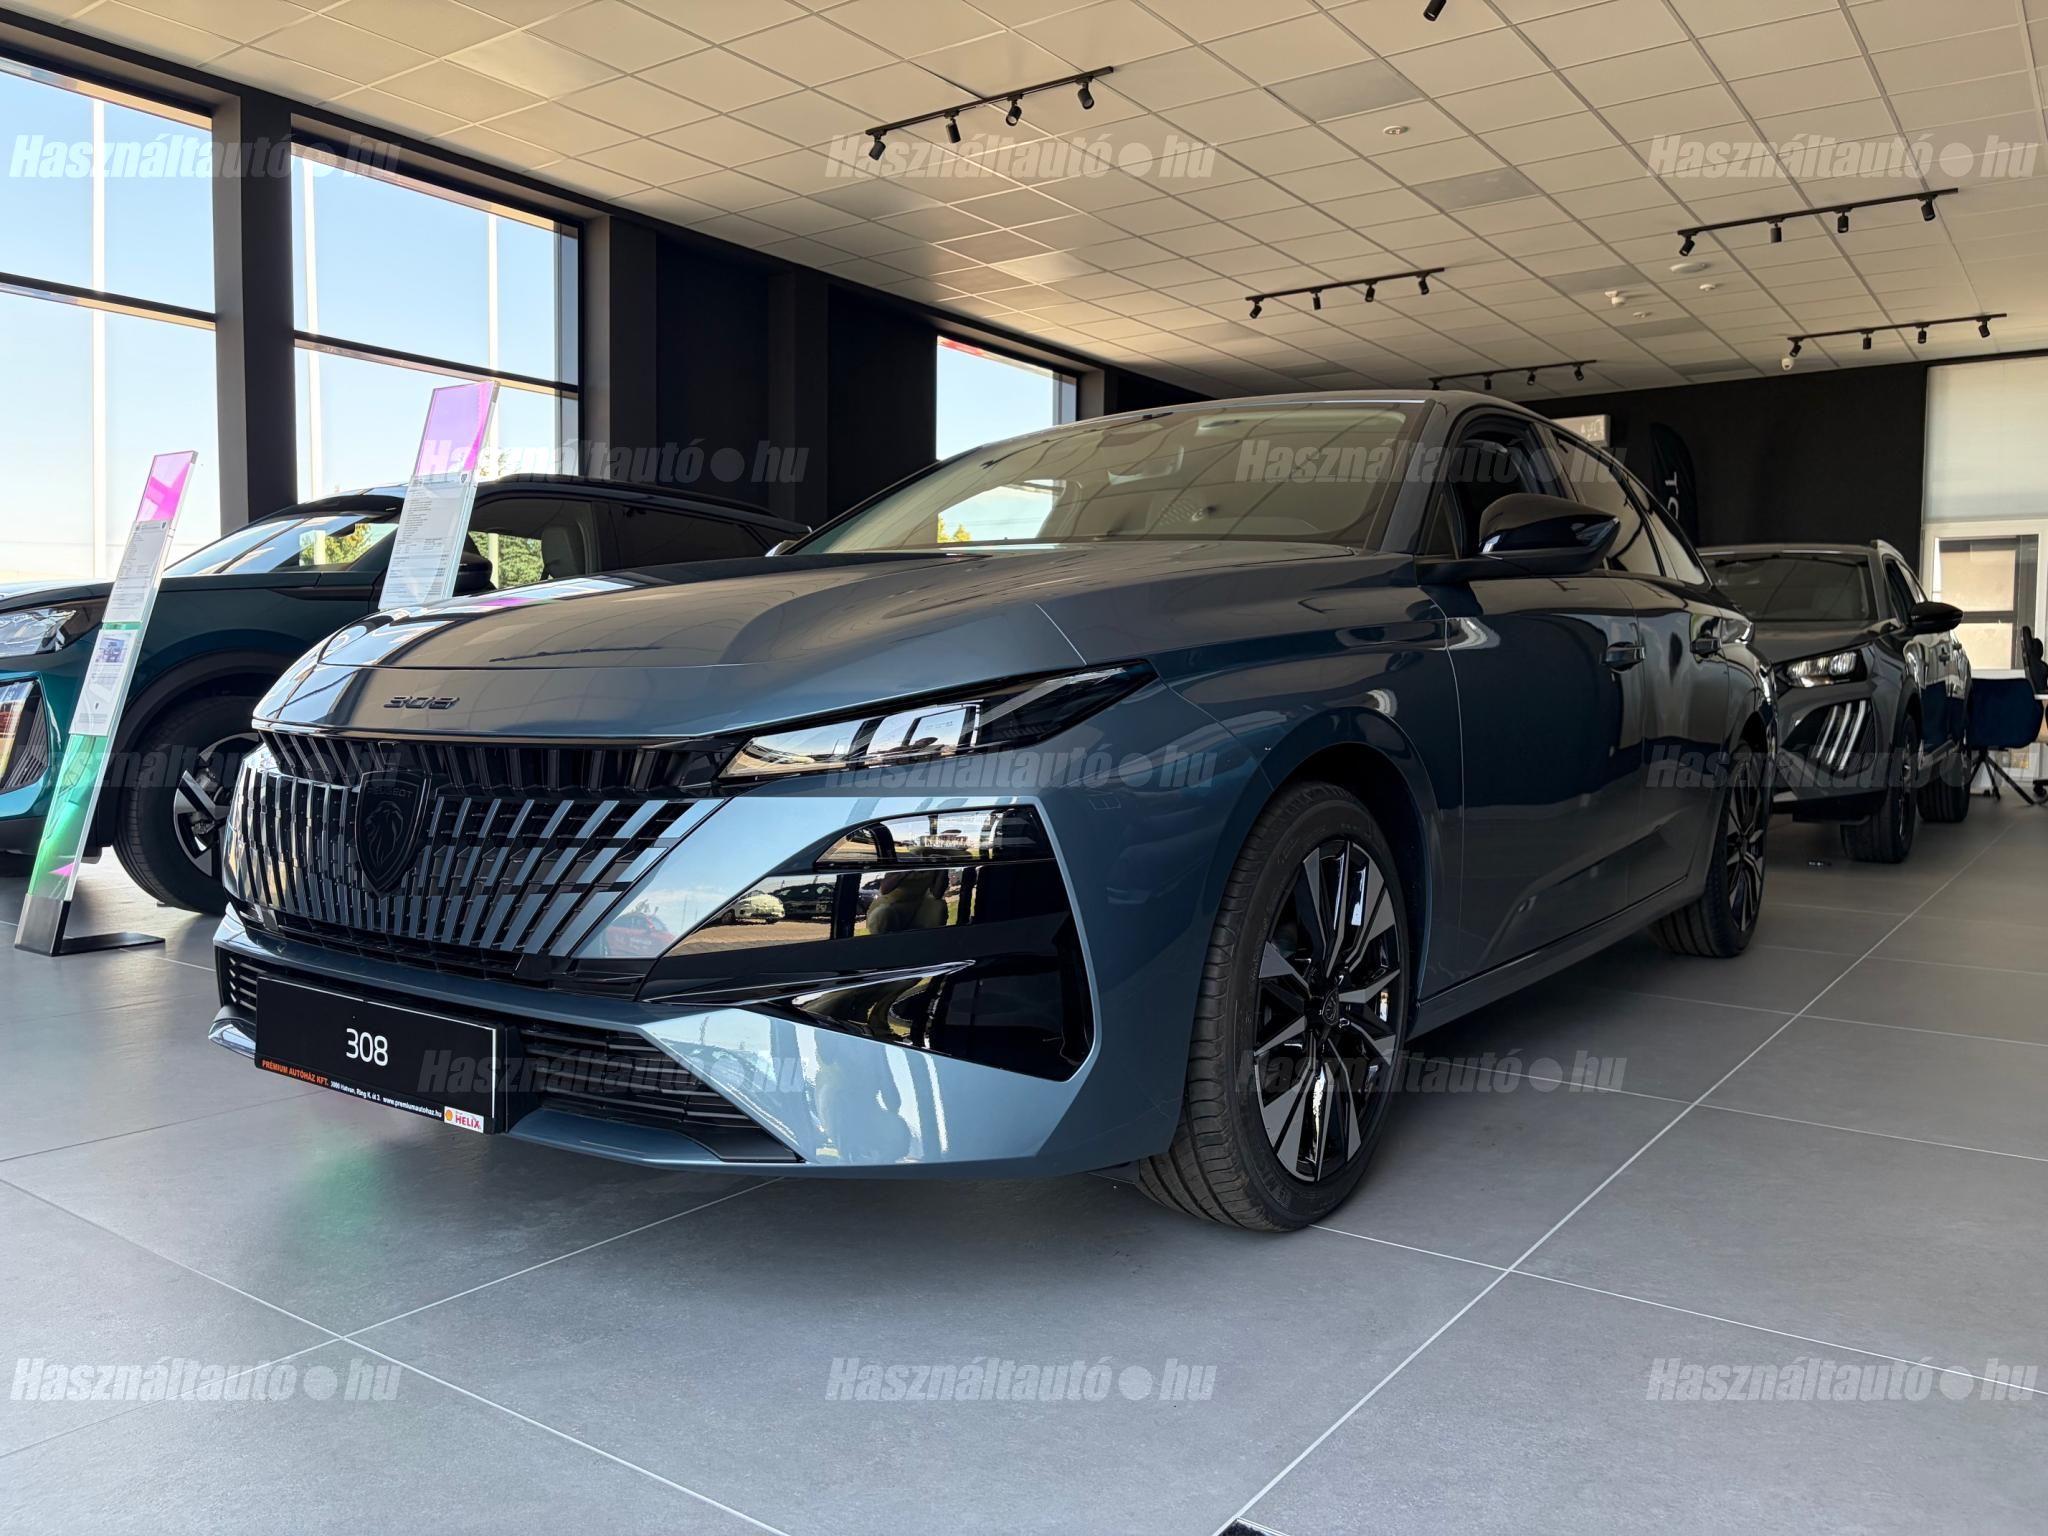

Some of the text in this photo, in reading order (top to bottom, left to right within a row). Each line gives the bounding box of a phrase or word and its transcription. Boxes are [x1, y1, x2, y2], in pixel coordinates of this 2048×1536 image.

[384, 696, 460, 710] 308
[346, 1028, 388, 1066] 308
[262, 1060, 329, 1086] PRÉMIUM AUTÓHÁZ KFT.
[455, 1114, 481, 1129] HELIX
